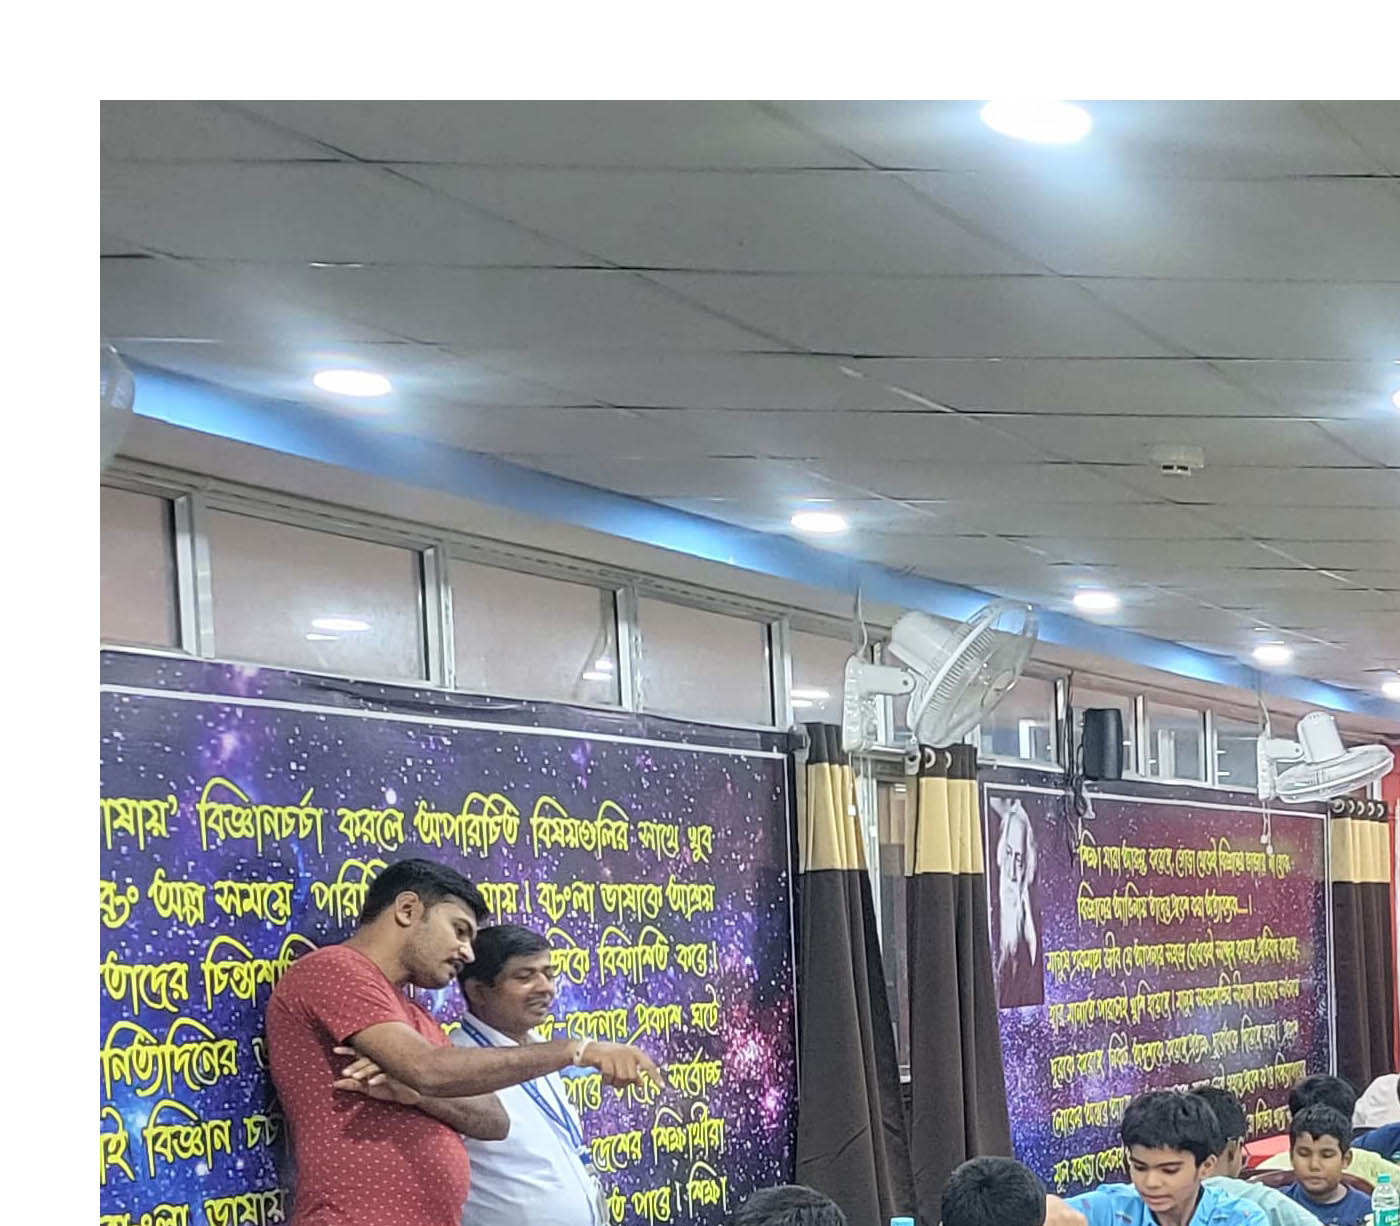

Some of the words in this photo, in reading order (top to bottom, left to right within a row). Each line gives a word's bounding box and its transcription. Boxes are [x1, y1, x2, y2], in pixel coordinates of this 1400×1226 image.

[337, 808, 405, 852] করলে
[414, 791, 521, 857] অপরিচিত
[638, 820, 680, 860] সাথে
[688, 823, 714, 863] খুব
